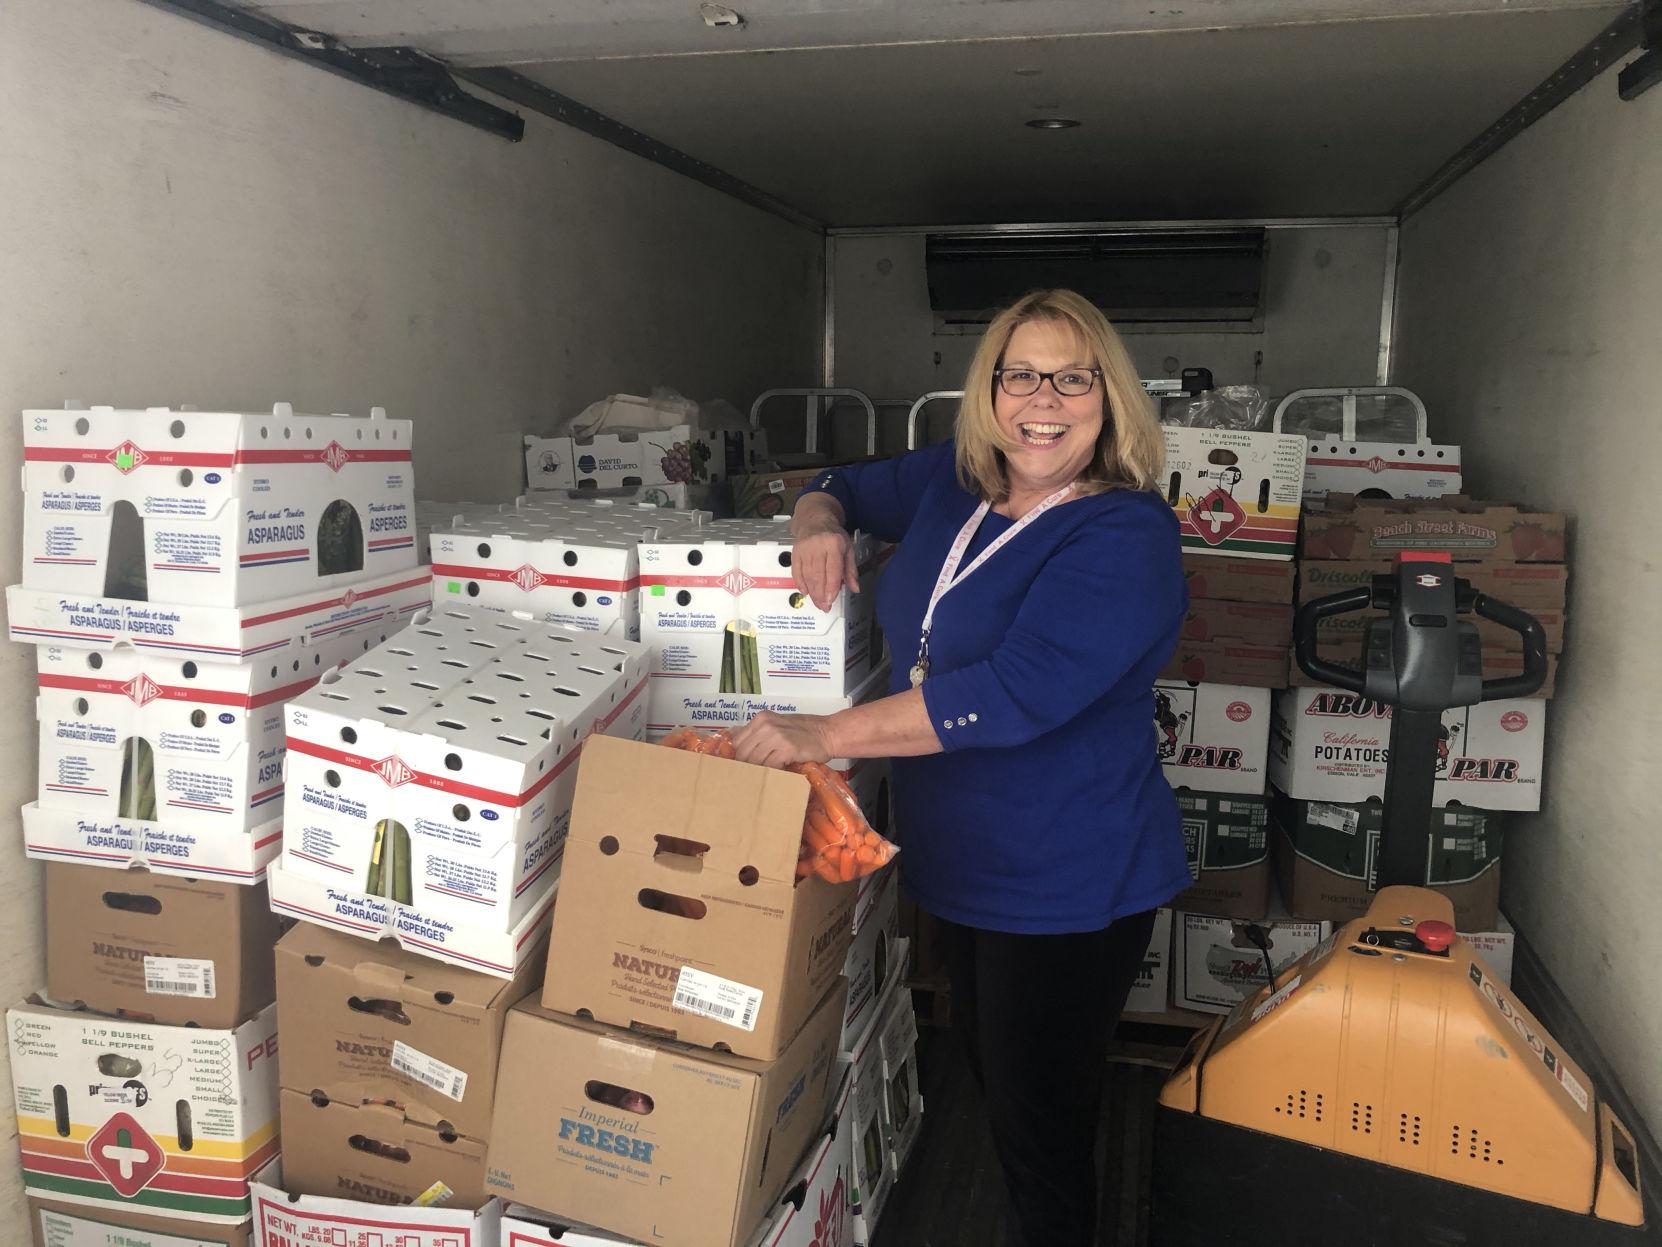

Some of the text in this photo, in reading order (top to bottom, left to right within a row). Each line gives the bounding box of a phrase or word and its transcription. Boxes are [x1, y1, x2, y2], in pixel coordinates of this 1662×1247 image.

[42, 500, 102, 512] ASPARAGUS ASPERGES
[247, 507, 305, 522] Fresh and Tender
[247, 524, 305, 544] ASPARAGUS
[370, 516, 408, 532] ASPERGES
[1374, 520, 1496, 540] Beach Street Farms
[60, 600, 80, 616] Fresh
[82, 604, 94, 614] and
[96, 604, 120, 616] Tender
[126, 606, 152, 620] Fraiche
[159, 612, 180, 622] tendre
[70, 614, 174, 636] ASPARAGUS ASPERGES
[658, 620, 717, 628] ASPARAGUS ASPERGES
[684, 698, 702, 709] Fresh
[704, 700, 718, 708] and
[776, 704, 797, 712] tendre
[1305, 692, 1393, 720] ABOV
[56, 729, 116, 744] ASPARAGUS ASPERGES
[1323, 731, 1378, 747] California
[1176, 744, 1244, 771] PAR
[1314, 746, 1390, 762] POTATOES
[345, 756, 412, 787] SINCE JMB
[1316, 765, 1358, 773] KIRSCHENMAN
[1448, 758, 1520, 784] PAR
[302, 793, 368, 820] ASPARAGUS ASPERGES
[77, 820, 98, 832] Fresh
[100, 826, 112, 834] and
[114, 824, 136, 836] Tend
[176, 833, 198, 844] tendre
[86, 836, 190, 858] ASPARAGU ASPERGES
[523, 821, 568, 874] ASPARAGUS
[326, 889, 348, 901] Fresh
[350, 898, 365, 906] and
[366, 899, 387, 912] Tend
[398, 908, 423, 923] Fraiche
[431, 918, 454, 932] tendre
[336, 904, 446, 942] ASPARAGUS ASPERGES
[92, 942, 151, 962] NATUR
[640, 944, 658, 956] Sysco
[612, 952, 681, 982] NATUR
[624, 972, 643, 984] Hand
[630, 996, 670, 1012] SINCE DEPUIS
[81, 1038, 154, 1051] BELL PEPPERS
[111, 1030, 154, 1041] BUSHEL
[28, 1049, 59, 1058] ORANGE
[336, 1040, 392, 1058] NATU
[192, 1094, 222, 1103] CHOICE
[578, 1106, 640, 1134] Imperial
[558, 1118, 655, 1164] FRESH
[337, 1176, 414, 1205] NATUR
[267, 1213, 282, 1229] NET
[284, 1219, 300, 1238] WT.
[308, 1226, 322, 1234] LBS.
[358, 1232, 366, 1240] 25
[432, 1238, 442, 1246] 35
